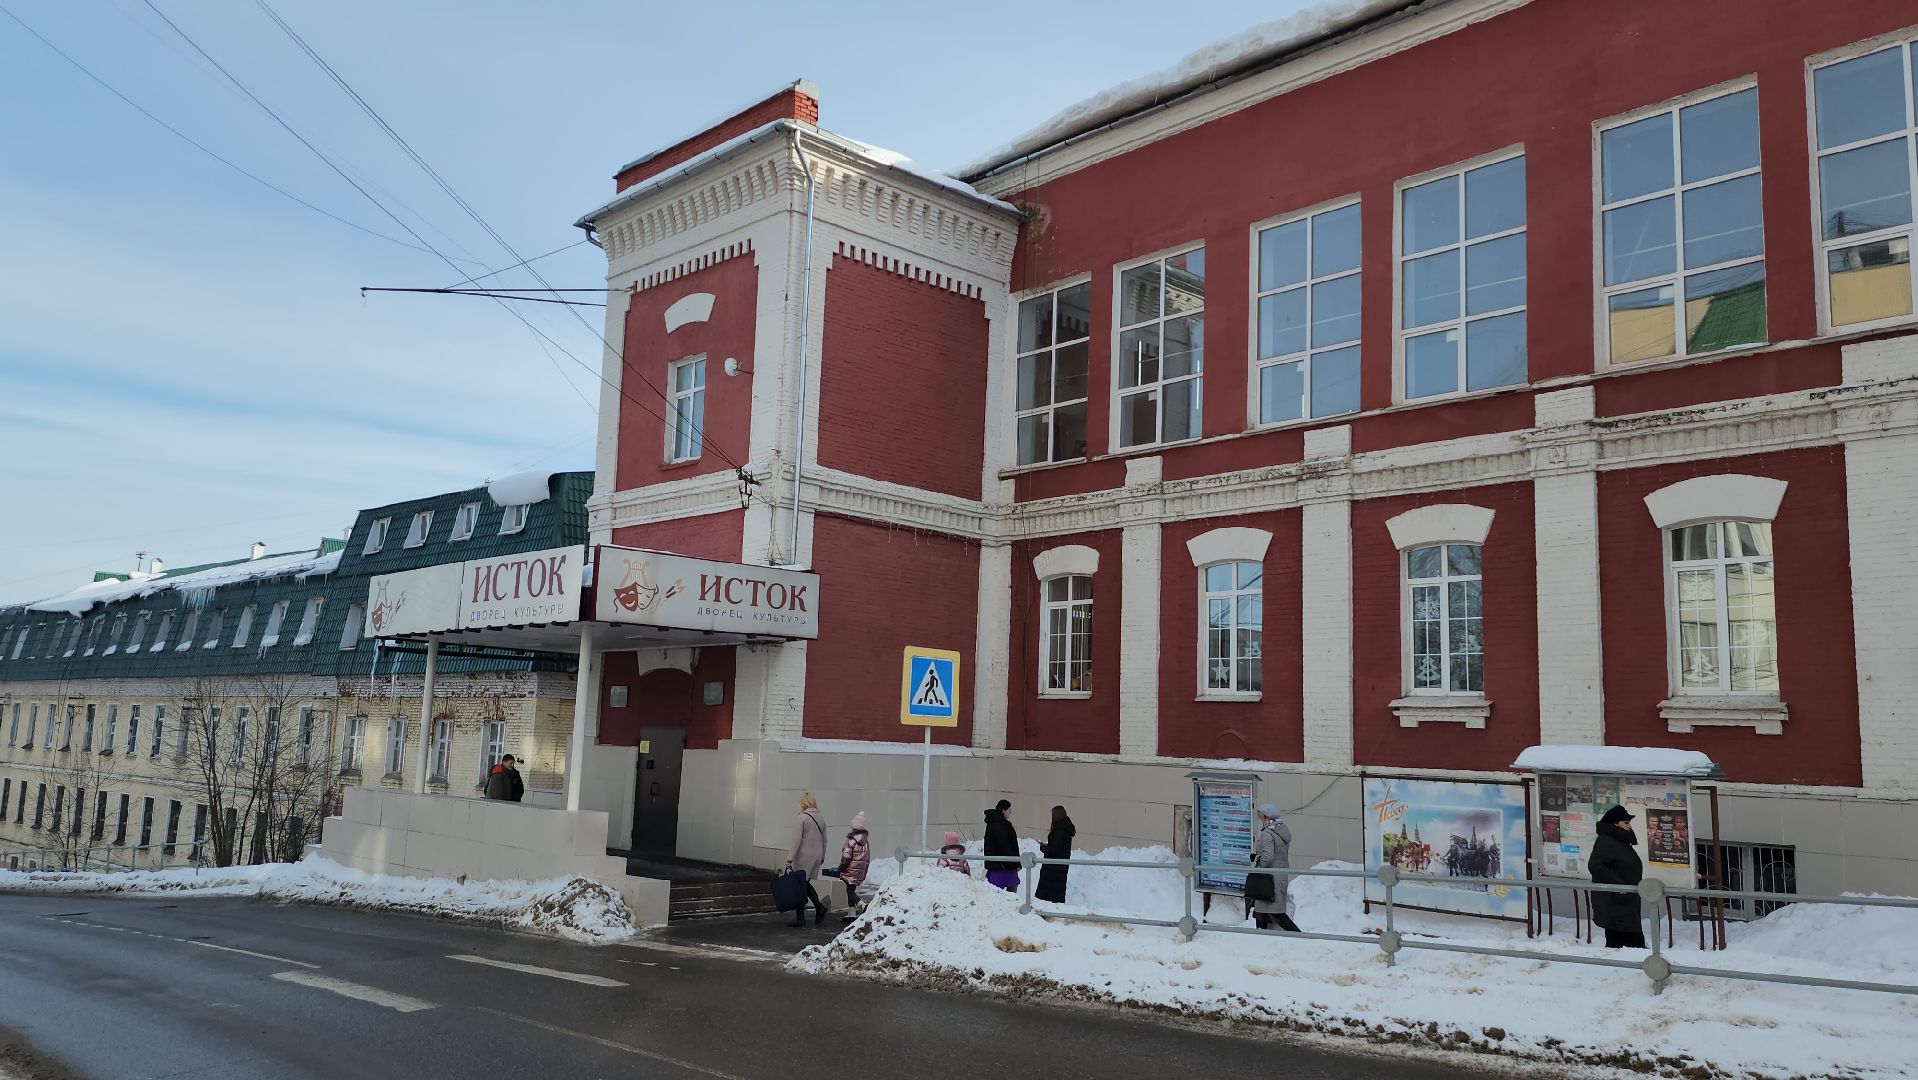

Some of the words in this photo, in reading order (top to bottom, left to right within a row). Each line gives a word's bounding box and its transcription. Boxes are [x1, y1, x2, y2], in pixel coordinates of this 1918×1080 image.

[472, 554, 567, 603] ИСТОК
[698, 574, 808, 612] ИСТОК
[470, 610, 506, 622] ДВОРЕЦ
[514, 603, 564, 618] КУЛЬТУРЫ
[697, 606, 743, 620] ДВОРЕЦ
[752, 611, 808, 625] КУЛЬТУРЫ
